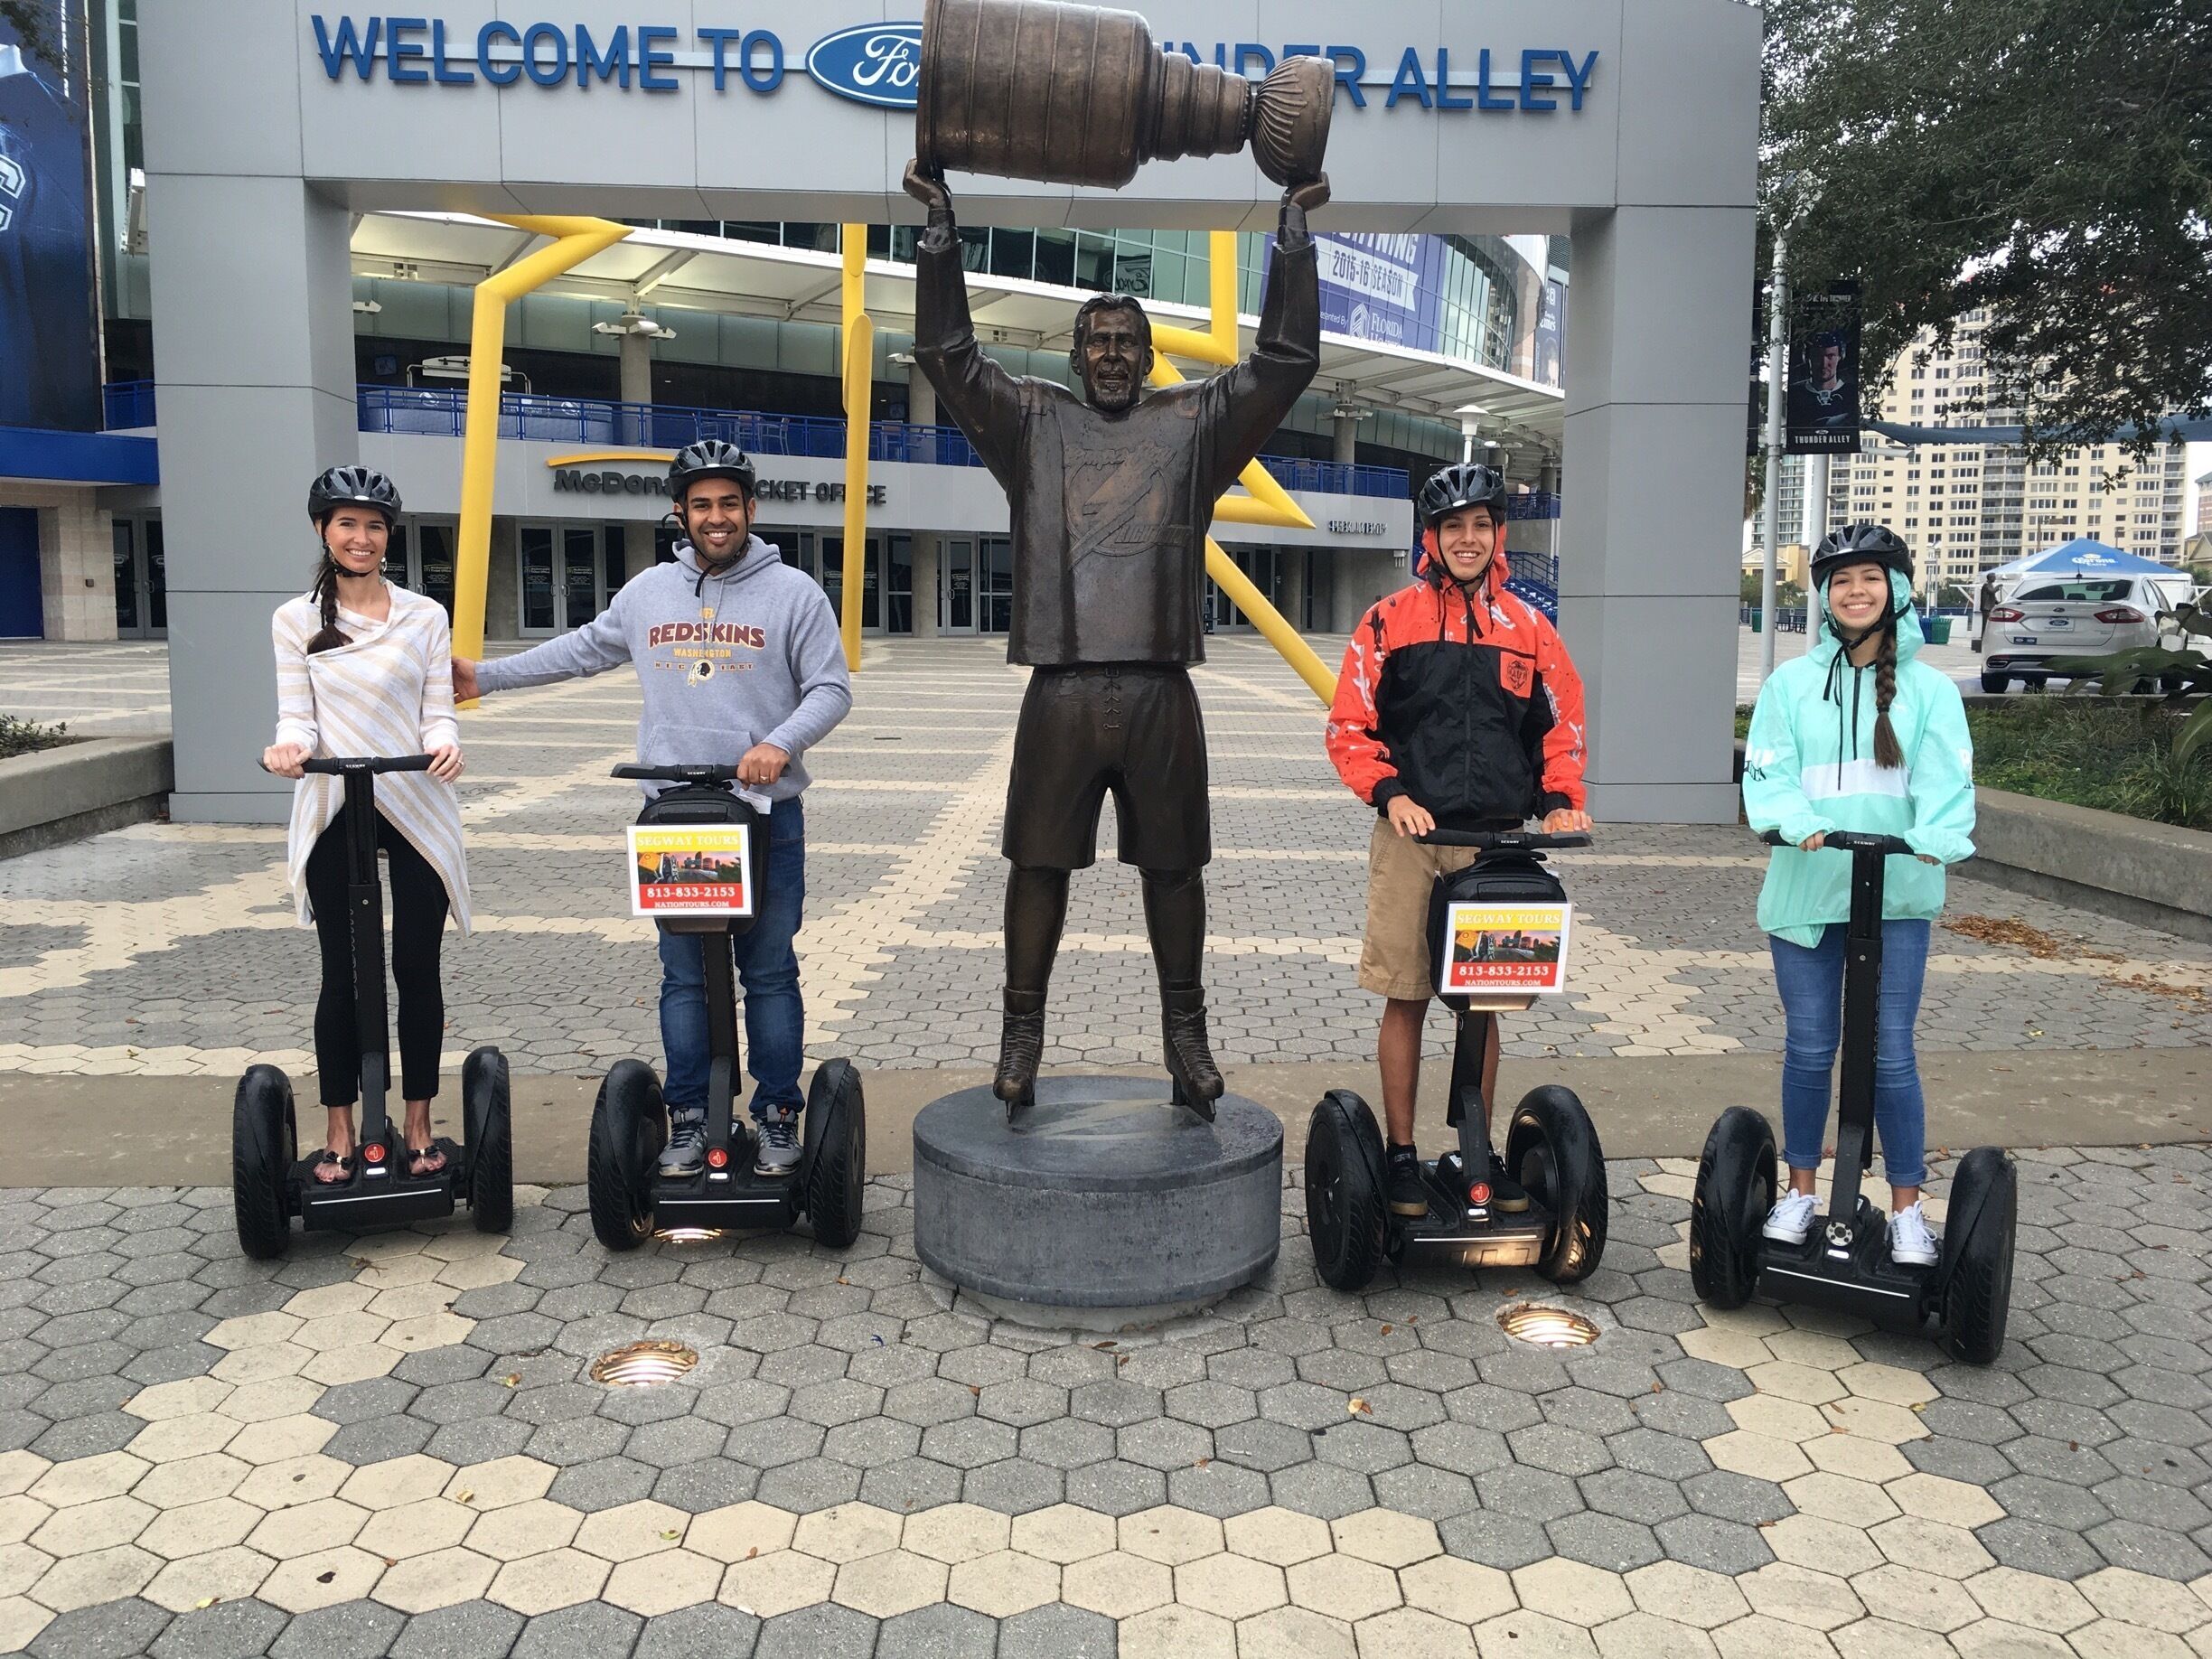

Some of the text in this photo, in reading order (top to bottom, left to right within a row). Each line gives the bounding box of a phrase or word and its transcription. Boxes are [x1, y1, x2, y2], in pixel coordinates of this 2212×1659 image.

[311, 15, 679, 89] WELCOME
[697, 28, 783, 91] TO
[852, 34, 923, 87] Fo
[1385, 47, 1599, 110] ALLEY
[1333, 250, 1403, 298] 2015-16 SEASON
[1371, 313, 1402, 339] FLORIDA
[1795, 435, 1851, 444] THUNDER ALLEY
[755, 479, 811, 501] CKET
[648, 621, 766, 650] REDSKINS
[674, 648, 731, 658] WASHINGTON
[637, 835, 739, 847] SEGWAY TOURS
[646, 886, 736, 898] 813-833-2153
[1457, 914, 1561, 924] SEGWAY TOURS
[1458, 966, 1550, 976] 813-833-2153
